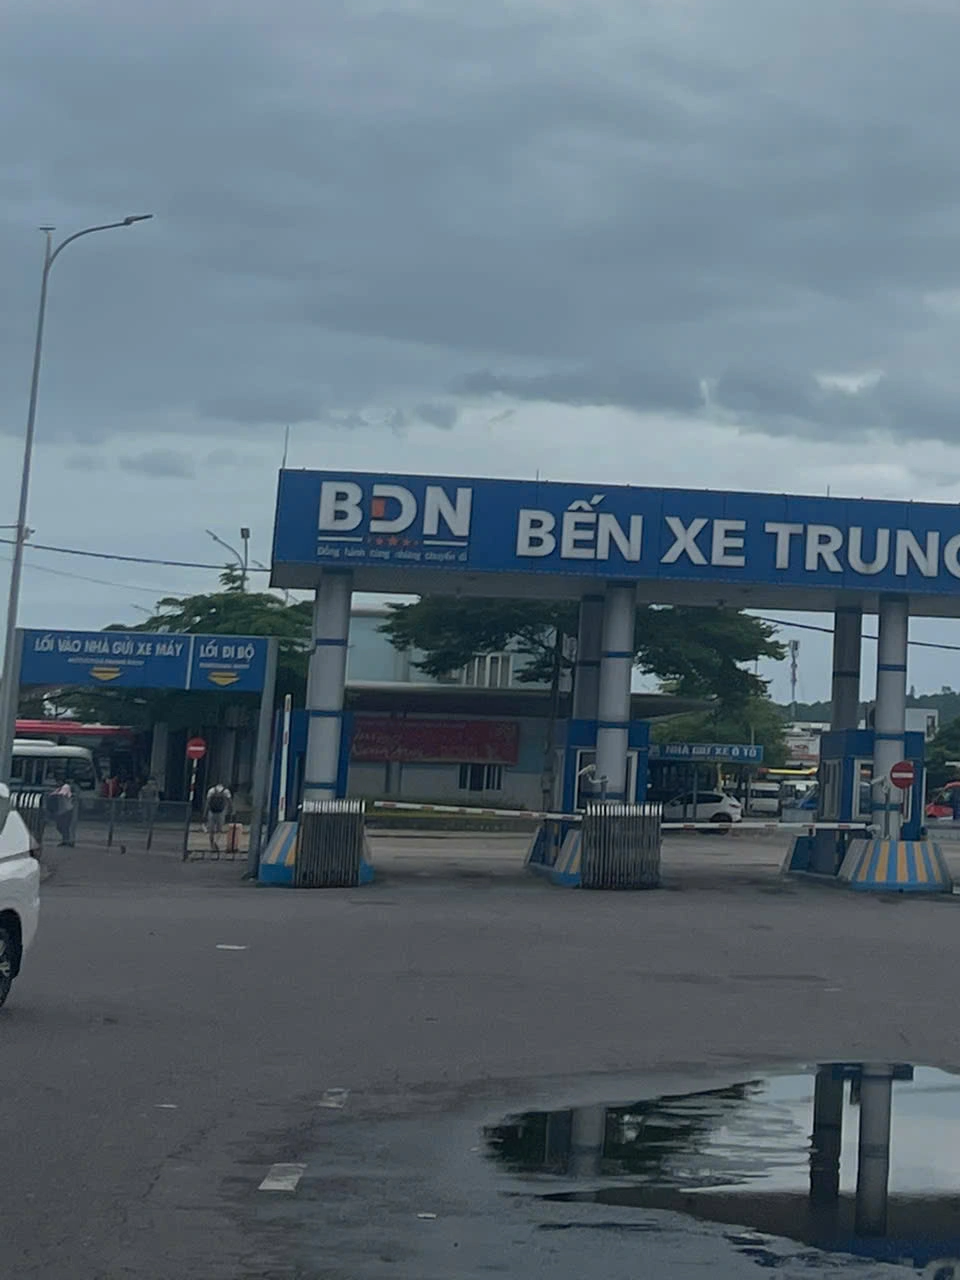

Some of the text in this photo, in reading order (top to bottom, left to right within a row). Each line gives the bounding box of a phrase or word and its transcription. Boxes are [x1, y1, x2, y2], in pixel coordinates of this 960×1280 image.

[318, 481, 472, 537] BDN
[516, 494, 643, 561] BẾN
[660, 516, 746, 567] XE
[34, 634, 184, 658] LỐI VÀO NHÀ GỬI XE MÁY
[199, 639, 255, 662] LỐI ĐI BỘ
